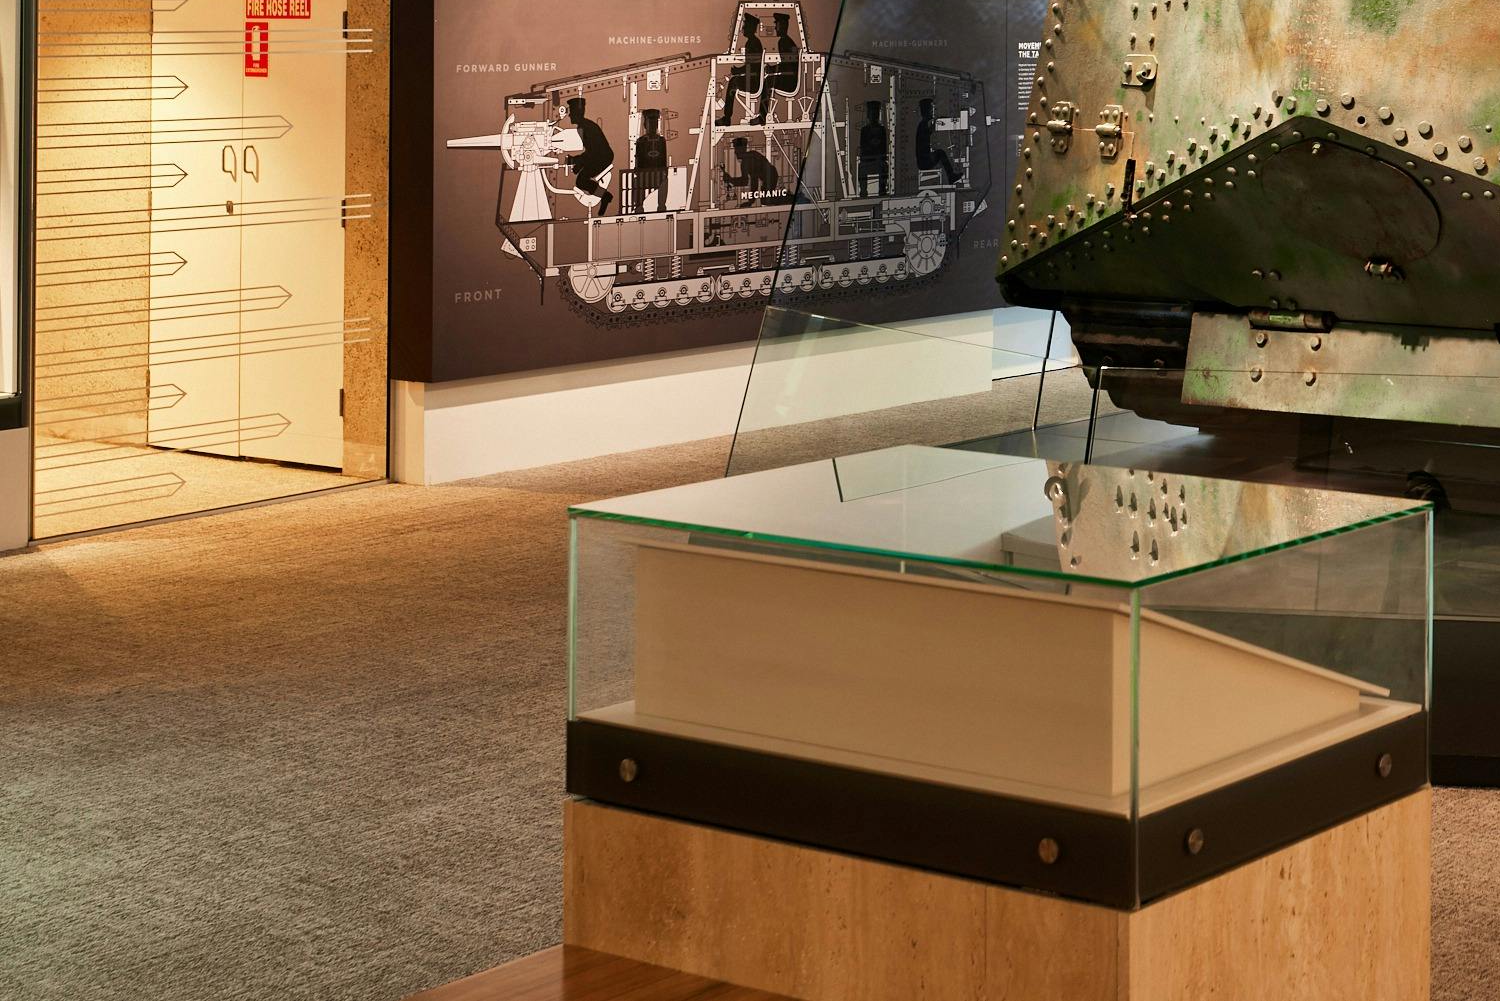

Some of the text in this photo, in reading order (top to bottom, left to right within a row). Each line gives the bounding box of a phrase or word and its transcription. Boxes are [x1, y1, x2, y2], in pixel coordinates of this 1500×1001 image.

[608, 35, 702, 45] MACHINE-GUNNERS
[1018, 42, 1041, 50] MOVEM
[456, 62, 557, 73] FORWARD GUNNER
[741, 188, 787, 199] MECHANIC
[973, 238, 999, 249] REAR
[454, 288, 502, 303] FRONT
